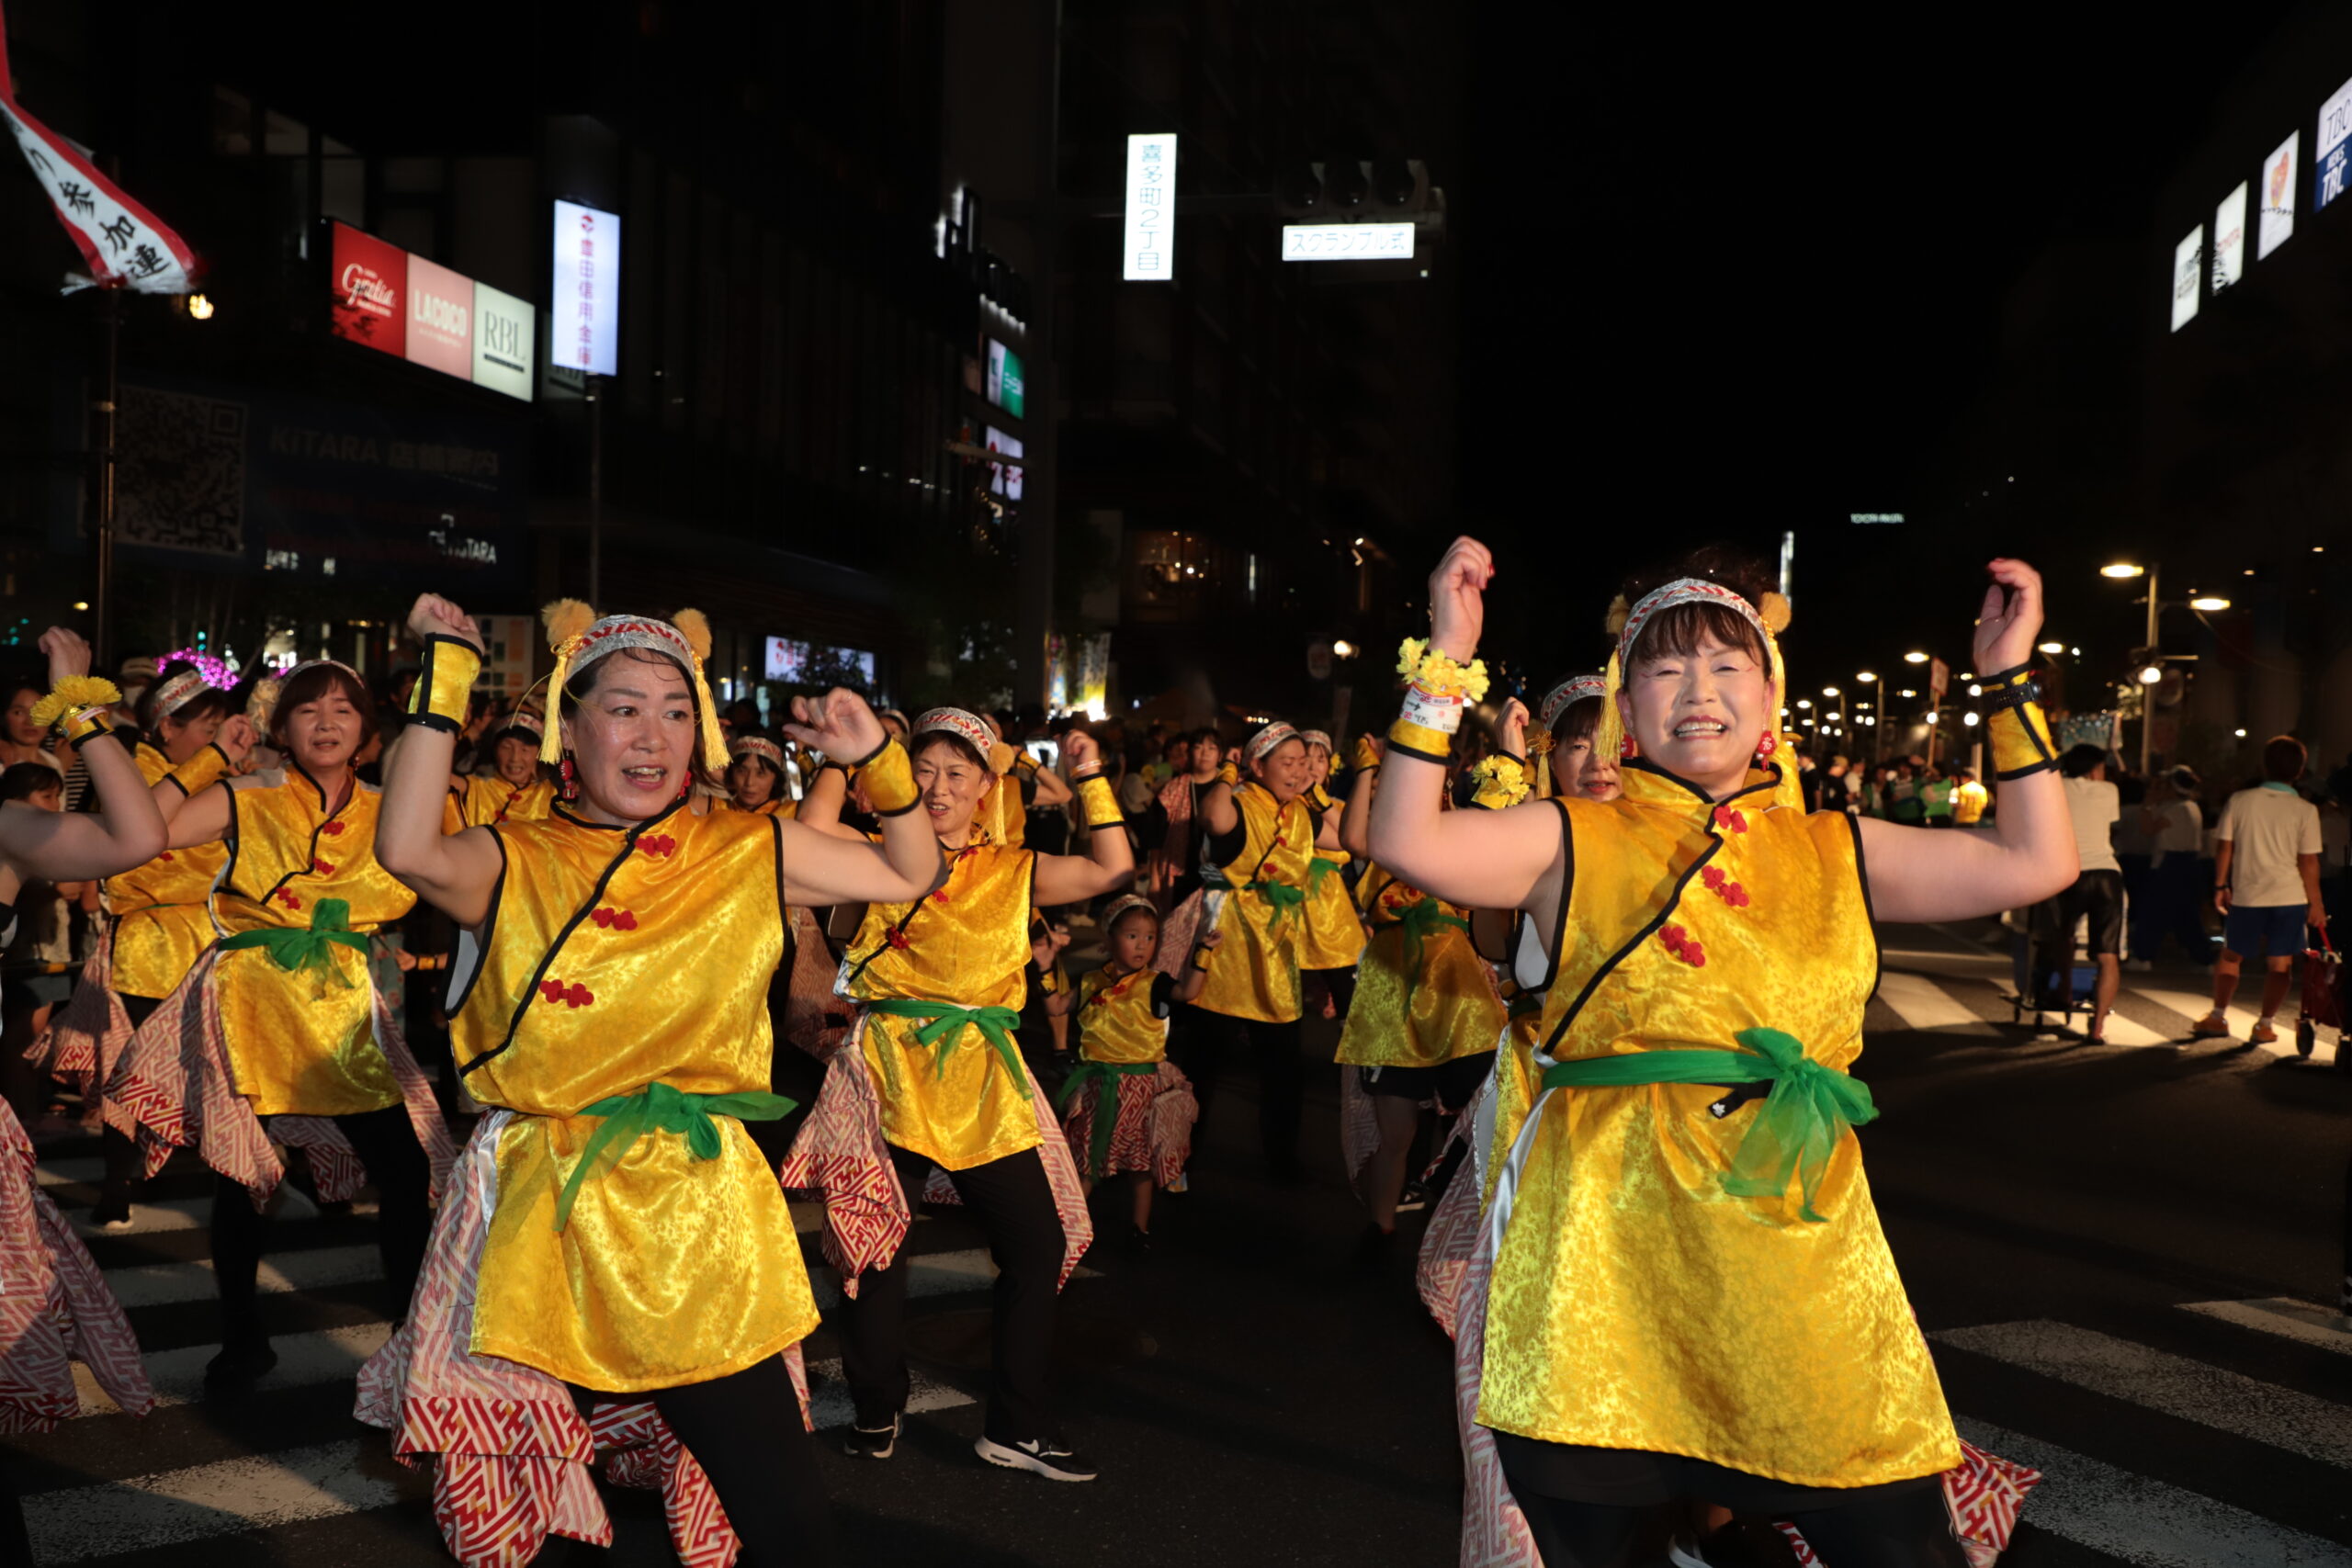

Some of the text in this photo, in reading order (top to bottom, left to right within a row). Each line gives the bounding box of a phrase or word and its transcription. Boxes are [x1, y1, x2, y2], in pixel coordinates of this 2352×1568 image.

[2326, 98, 2351, 145] TBC
[1137, 144, 1163, 270] 喜多町2丁目
[2322, 157, 2347, 207] TBC
[414, 289, 467, 337] LACOCO
[484, 310, 526, 361] RBL
